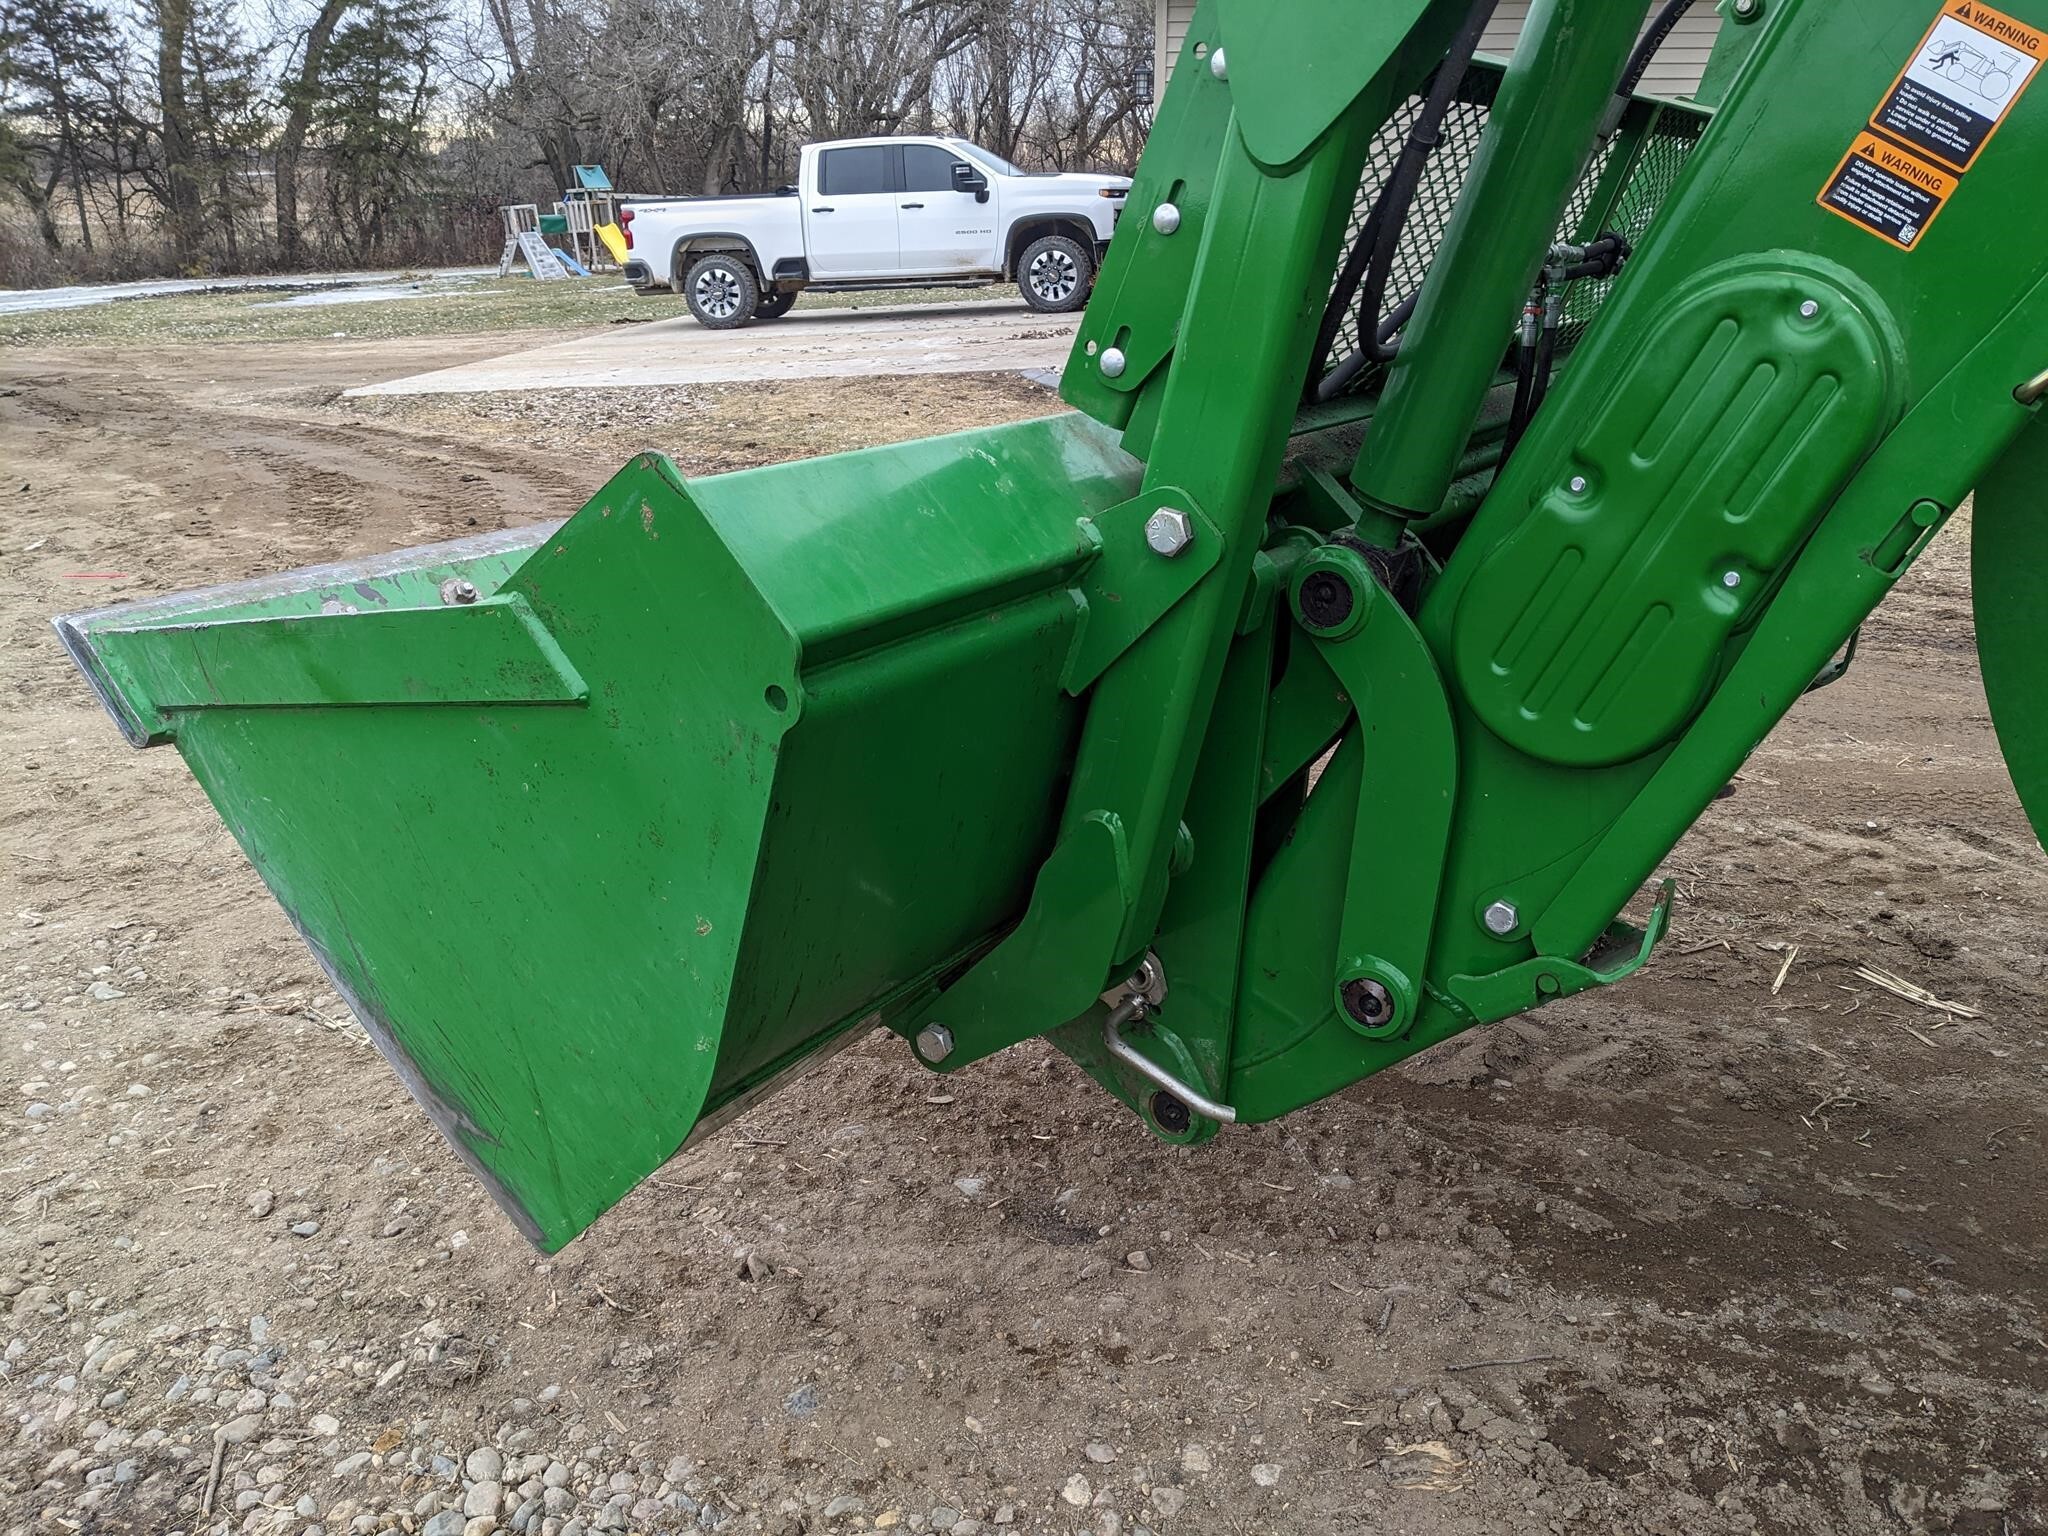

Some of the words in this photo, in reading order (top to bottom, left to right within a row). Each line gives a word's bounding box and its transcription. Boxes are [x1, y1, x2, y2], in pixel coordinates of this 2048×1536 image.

[1974, 10, 2040, 50] WARNING
[1899, 97, 1908, 105] Do
[1907, 103, 1918, 111] not
[1917, 108, 1930, 117] walk
[1936, 118, 1959, 132] perform
[1904, 82, 1911, 90] To
[1910, 87, 1927, 98] avoid
[1925, 94, 1942, 107] injury
[1941, 102, 1955, 113] from
[1954, 109, 1972, 122] falling
[1886, 117, 1907, 130] parked.
[1890, 110, 1908, 122] Lower
[1907, 118, 1925, 131] loader
[1931, 132, 1952, 145] ground
[1951, 142, 1966, 152] when
[1895, 105, 1915, 117] service
[1914, 115, 1931, 125] under
[1935, 125, 1953, 137] raised
[1851, 167, 1874, 182] engaging
[1873, 179, 1902, 196] attachment
[1855, 160, 1864, 168] DO
[1863, 164, 1876, 174] NOT
[1875, 171, 1895, 184] operate
[1894, 181, 1911, 193] loader
[1910, 190, 1930, 203] without
[1881, 151, 1942, 191] WARNING
[1844, 175, 1861, 187] Failure
[1867, 188, 1886, 201] engage
[1885, 198, 1905, 211] retainer
[1904, 208, 1920, 219] could
[1847, 201, 1862, 212] injury
[1867, 212, 1882, 224] death.
[1848, 193, 1865, 205] loader
[1864, 202, 1884, 217] causing
[1883, 213, 1902, 226] serious
[1859, 192, 1888, 210] attachment
[1887, 207, 1912, 224] detaching
